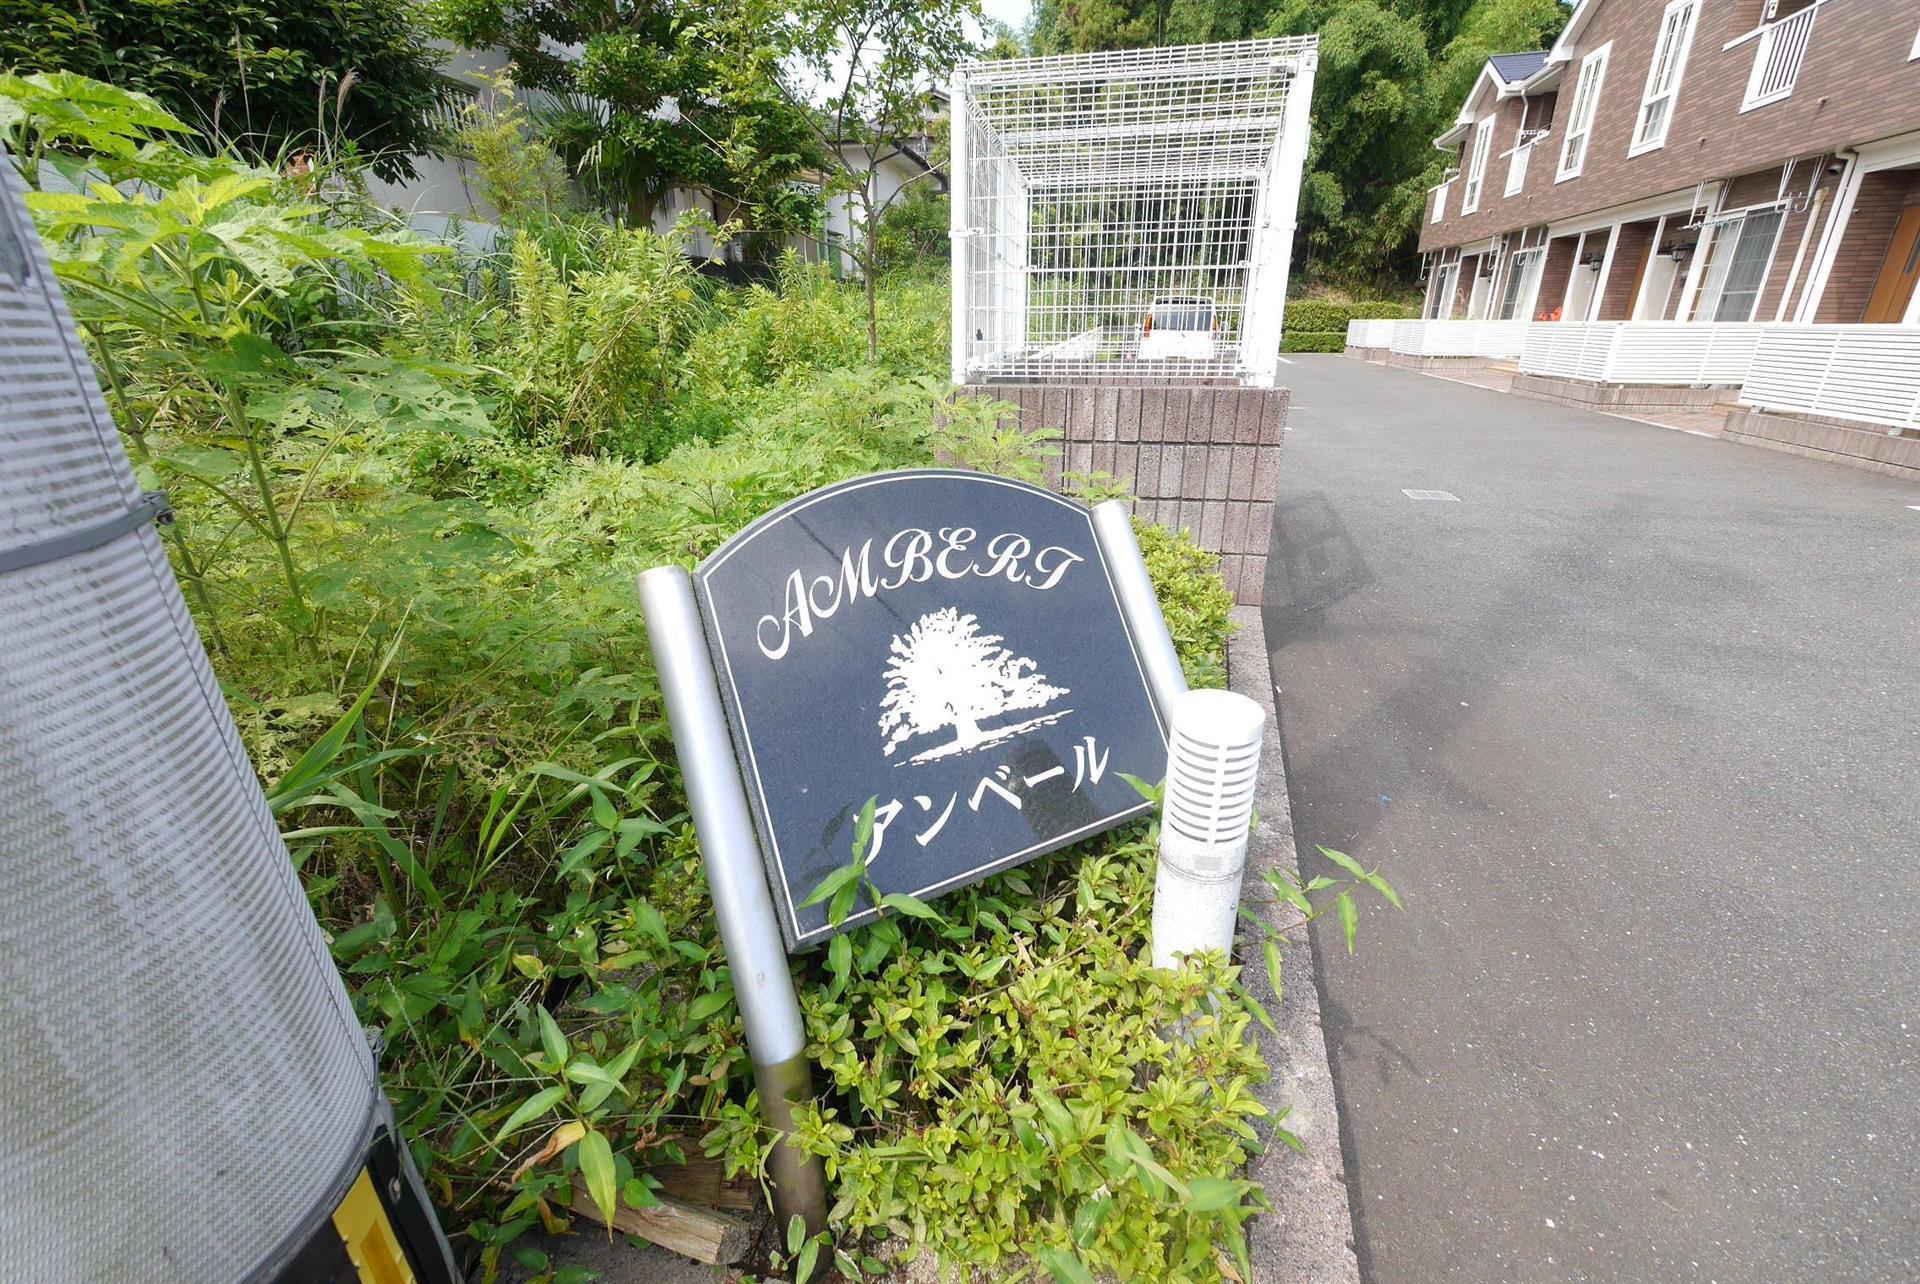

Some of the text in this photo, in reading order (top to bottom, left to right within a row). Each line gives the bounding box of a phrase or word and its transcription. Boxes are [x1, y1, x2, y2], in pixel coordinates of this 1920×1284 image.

[757, 527, 1085, 660] AMBERT
[853, 736, 1109, 867] アンベール
